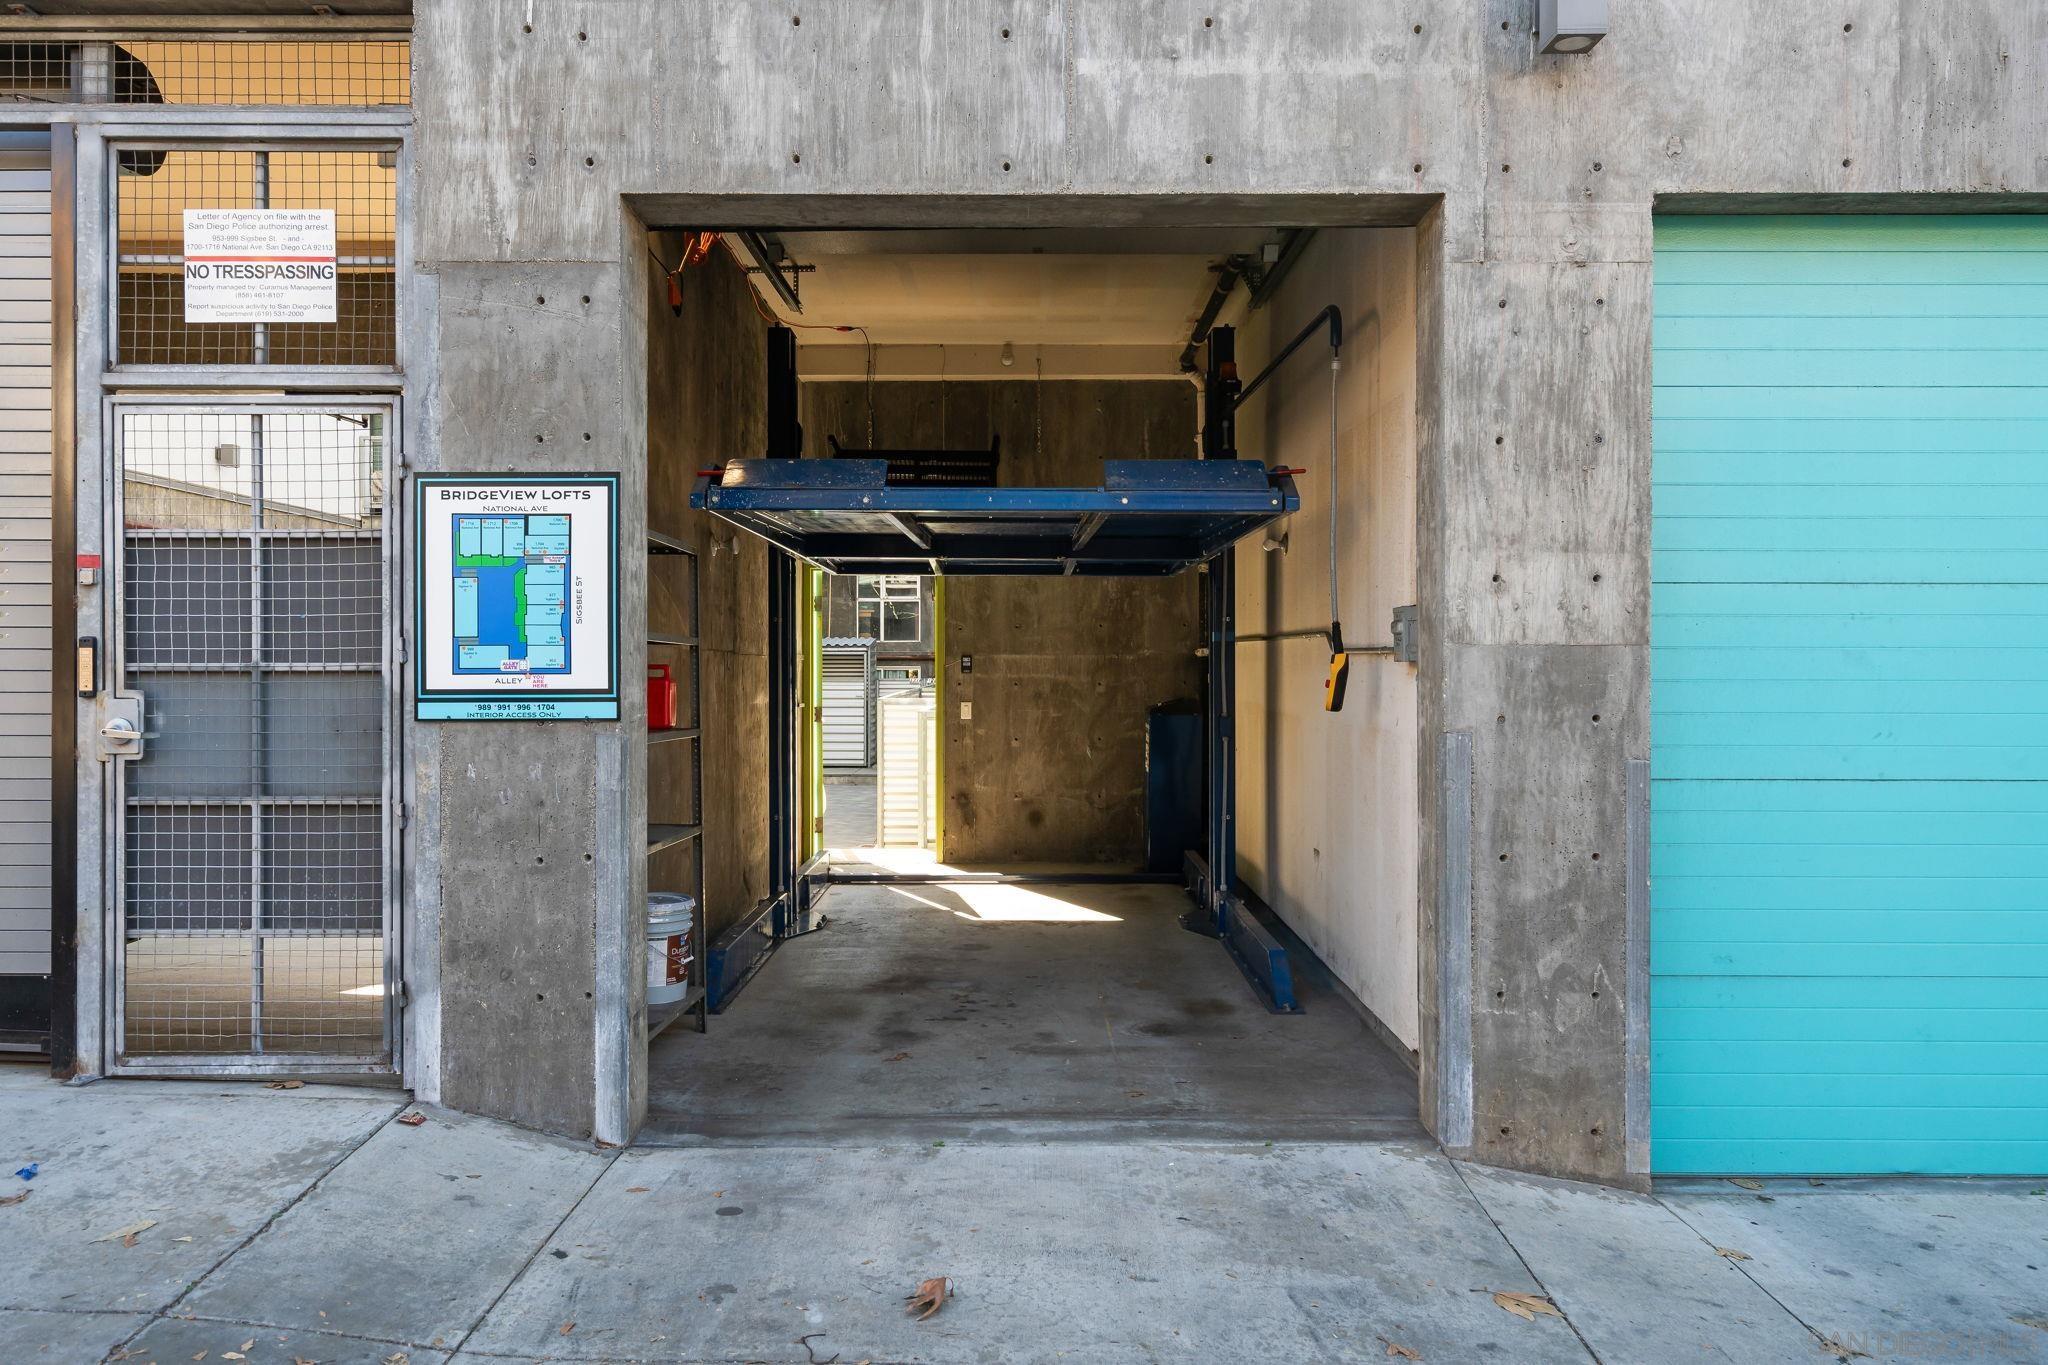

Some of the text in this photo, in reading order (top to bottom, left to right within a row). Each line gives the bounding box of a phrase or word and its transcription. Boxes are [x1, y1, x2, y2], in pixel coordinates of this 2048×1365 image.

[232, 213, 262, 222] Agency
[206, 223, 230, 231] Diego
[258, 223, 303, 231] authorizing
[281, 244, 300, 252] Diego
[186, 264, 334, 280] NO TRESSPASSING
[216, 284, 246, 292] managed
[290, 284, 333, 292] Management
[542, 489, 591, 500] LOFTS
[575, 575, 583, 587] ST
